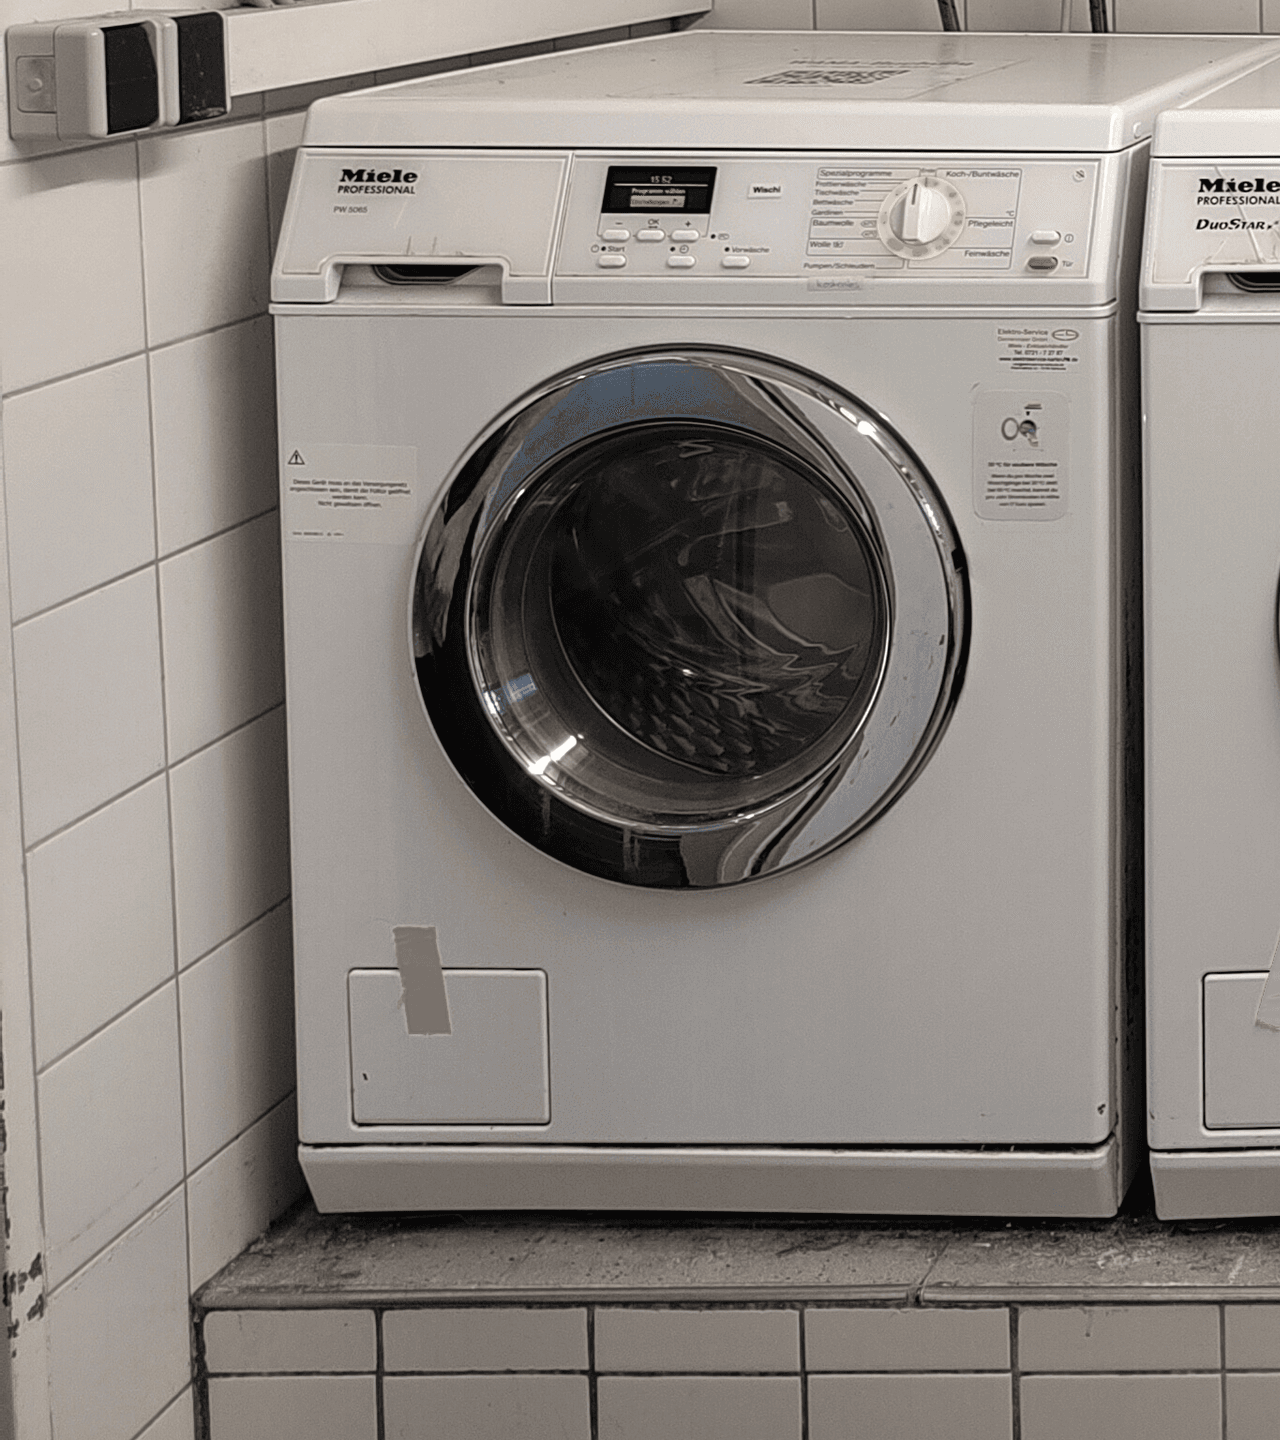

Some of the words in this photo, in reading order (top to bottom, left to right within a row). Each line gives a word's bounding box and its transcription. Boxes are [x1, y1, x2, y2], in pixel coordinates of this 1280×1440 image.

[338, 169, 419, 183] Miele
[820, 169, 893, 178] Spezialprogramme
[946, 170, 1019, 178] Koch-/Buntwäsche
[337, 184, 416, 195] PROFESSIONAL
[752, 185, 781, 194] Wischi
[1197, 196, 1280, 205] PROFESSIONAL
[333, 206, 348, 214] PW
[812, 219, 855, 227] Baumwolle
[967, 219, 1013, 228] Pflegeleicht
[809, 240, 832, 248] Wolle
[607, 245, 626, 253] Start
[731, 246, 770, 254] Vorwäsche
[964, 249, 1010, 257] Feinwäsche
